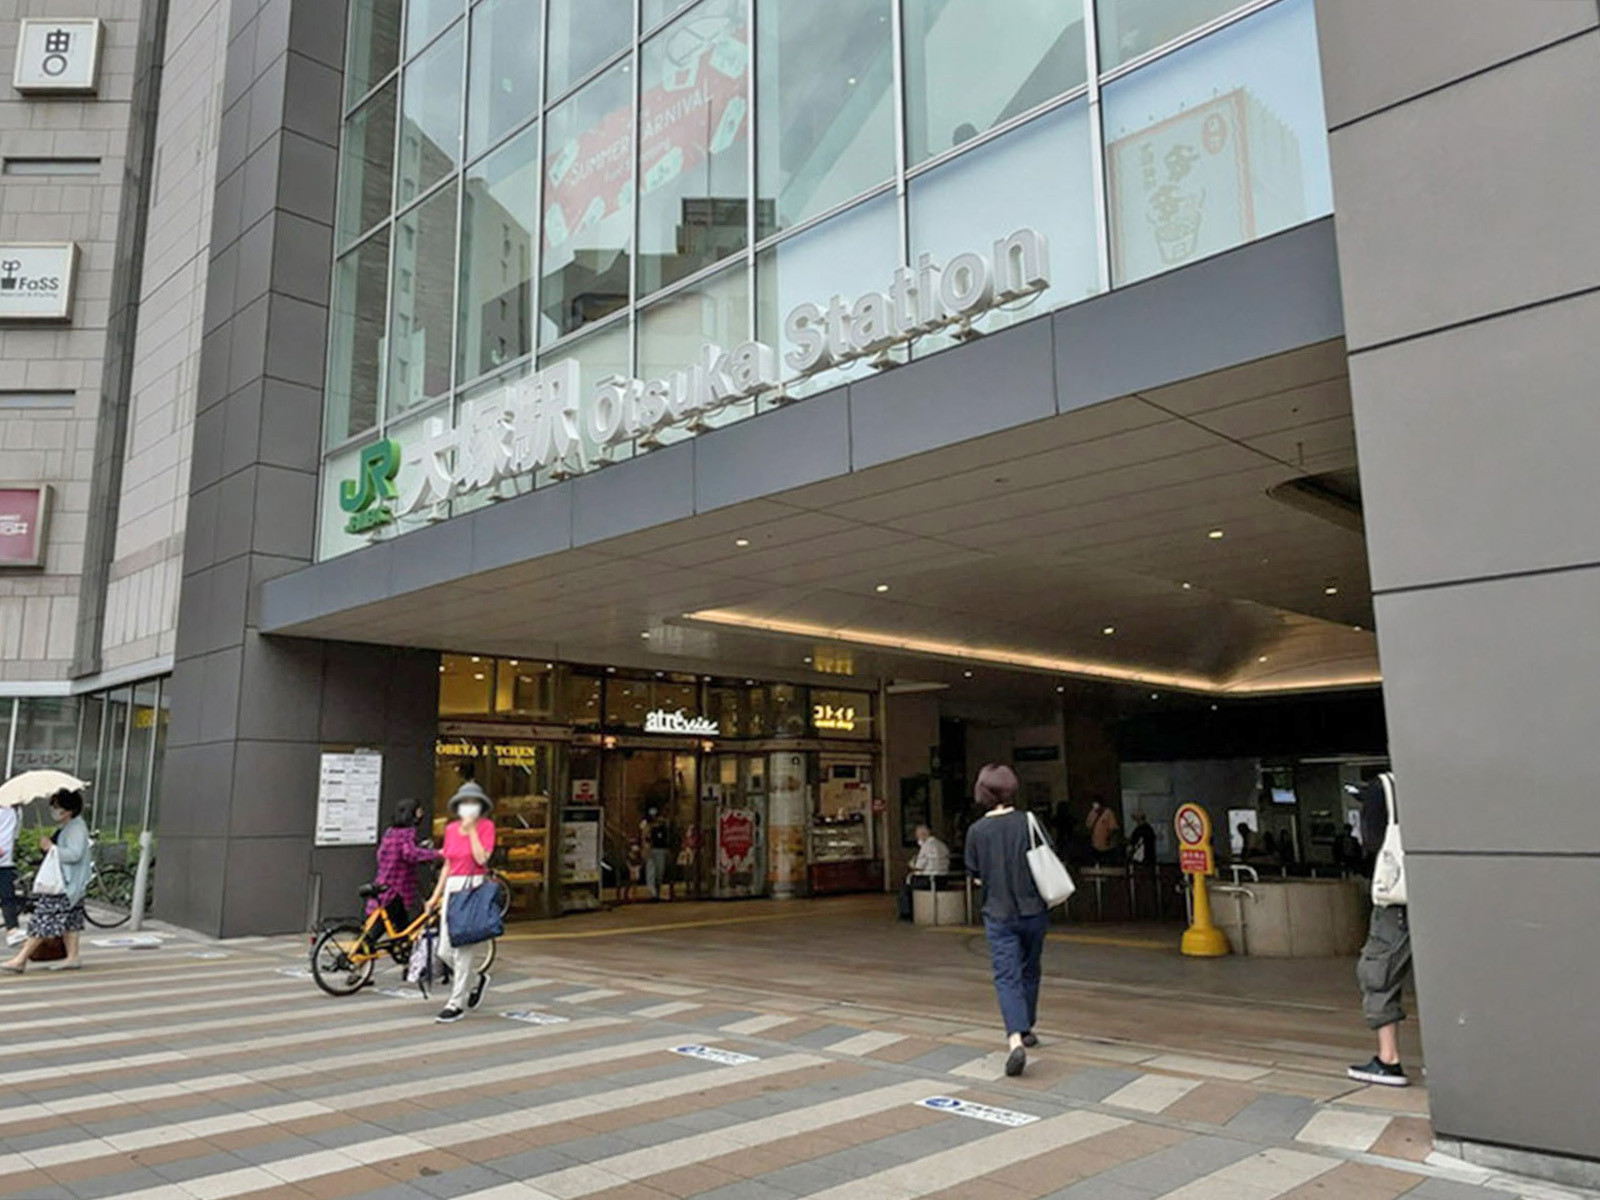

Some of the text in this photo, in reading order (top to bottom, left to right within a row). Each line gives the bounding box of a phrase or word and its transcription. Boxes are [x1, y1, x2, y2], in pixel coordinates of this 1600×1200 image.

[642, 87, 714, 138] ARNIVAL
[394, 227, 1049, 517] 大塚駅 Ōtsuka Station
[339, 438, 401, 513] JR
